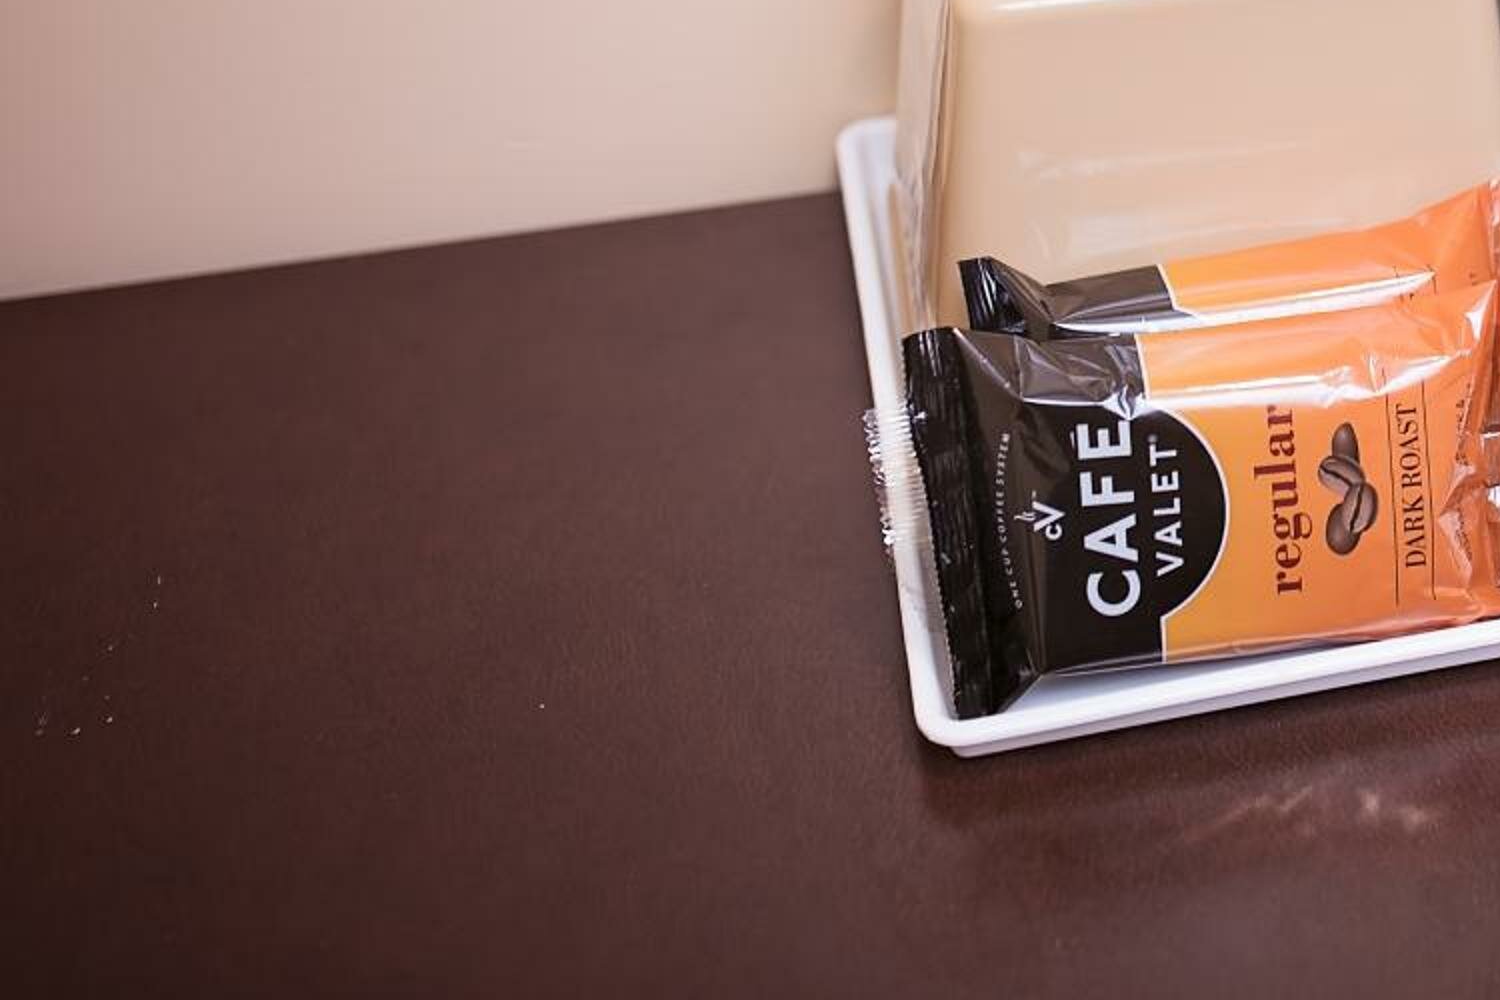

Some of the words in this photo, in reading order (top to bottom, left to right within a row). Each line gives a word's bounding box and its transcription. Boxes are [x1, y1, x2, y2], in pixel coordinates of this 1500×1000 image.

[995, 432, 1011, 486] SYSTEM
[1395, 403, 1422, 488] ROAST
[995, 491, 1007, 544] COFFEE
[1149, 443, 1185, 577] VALET
[1253, 404, 1313, 595] regular
[1001, 547, 1014, 576] CUP
[1402, 495, 1427, 568] DARK
[1009, 581, 1024, 609] ONE
